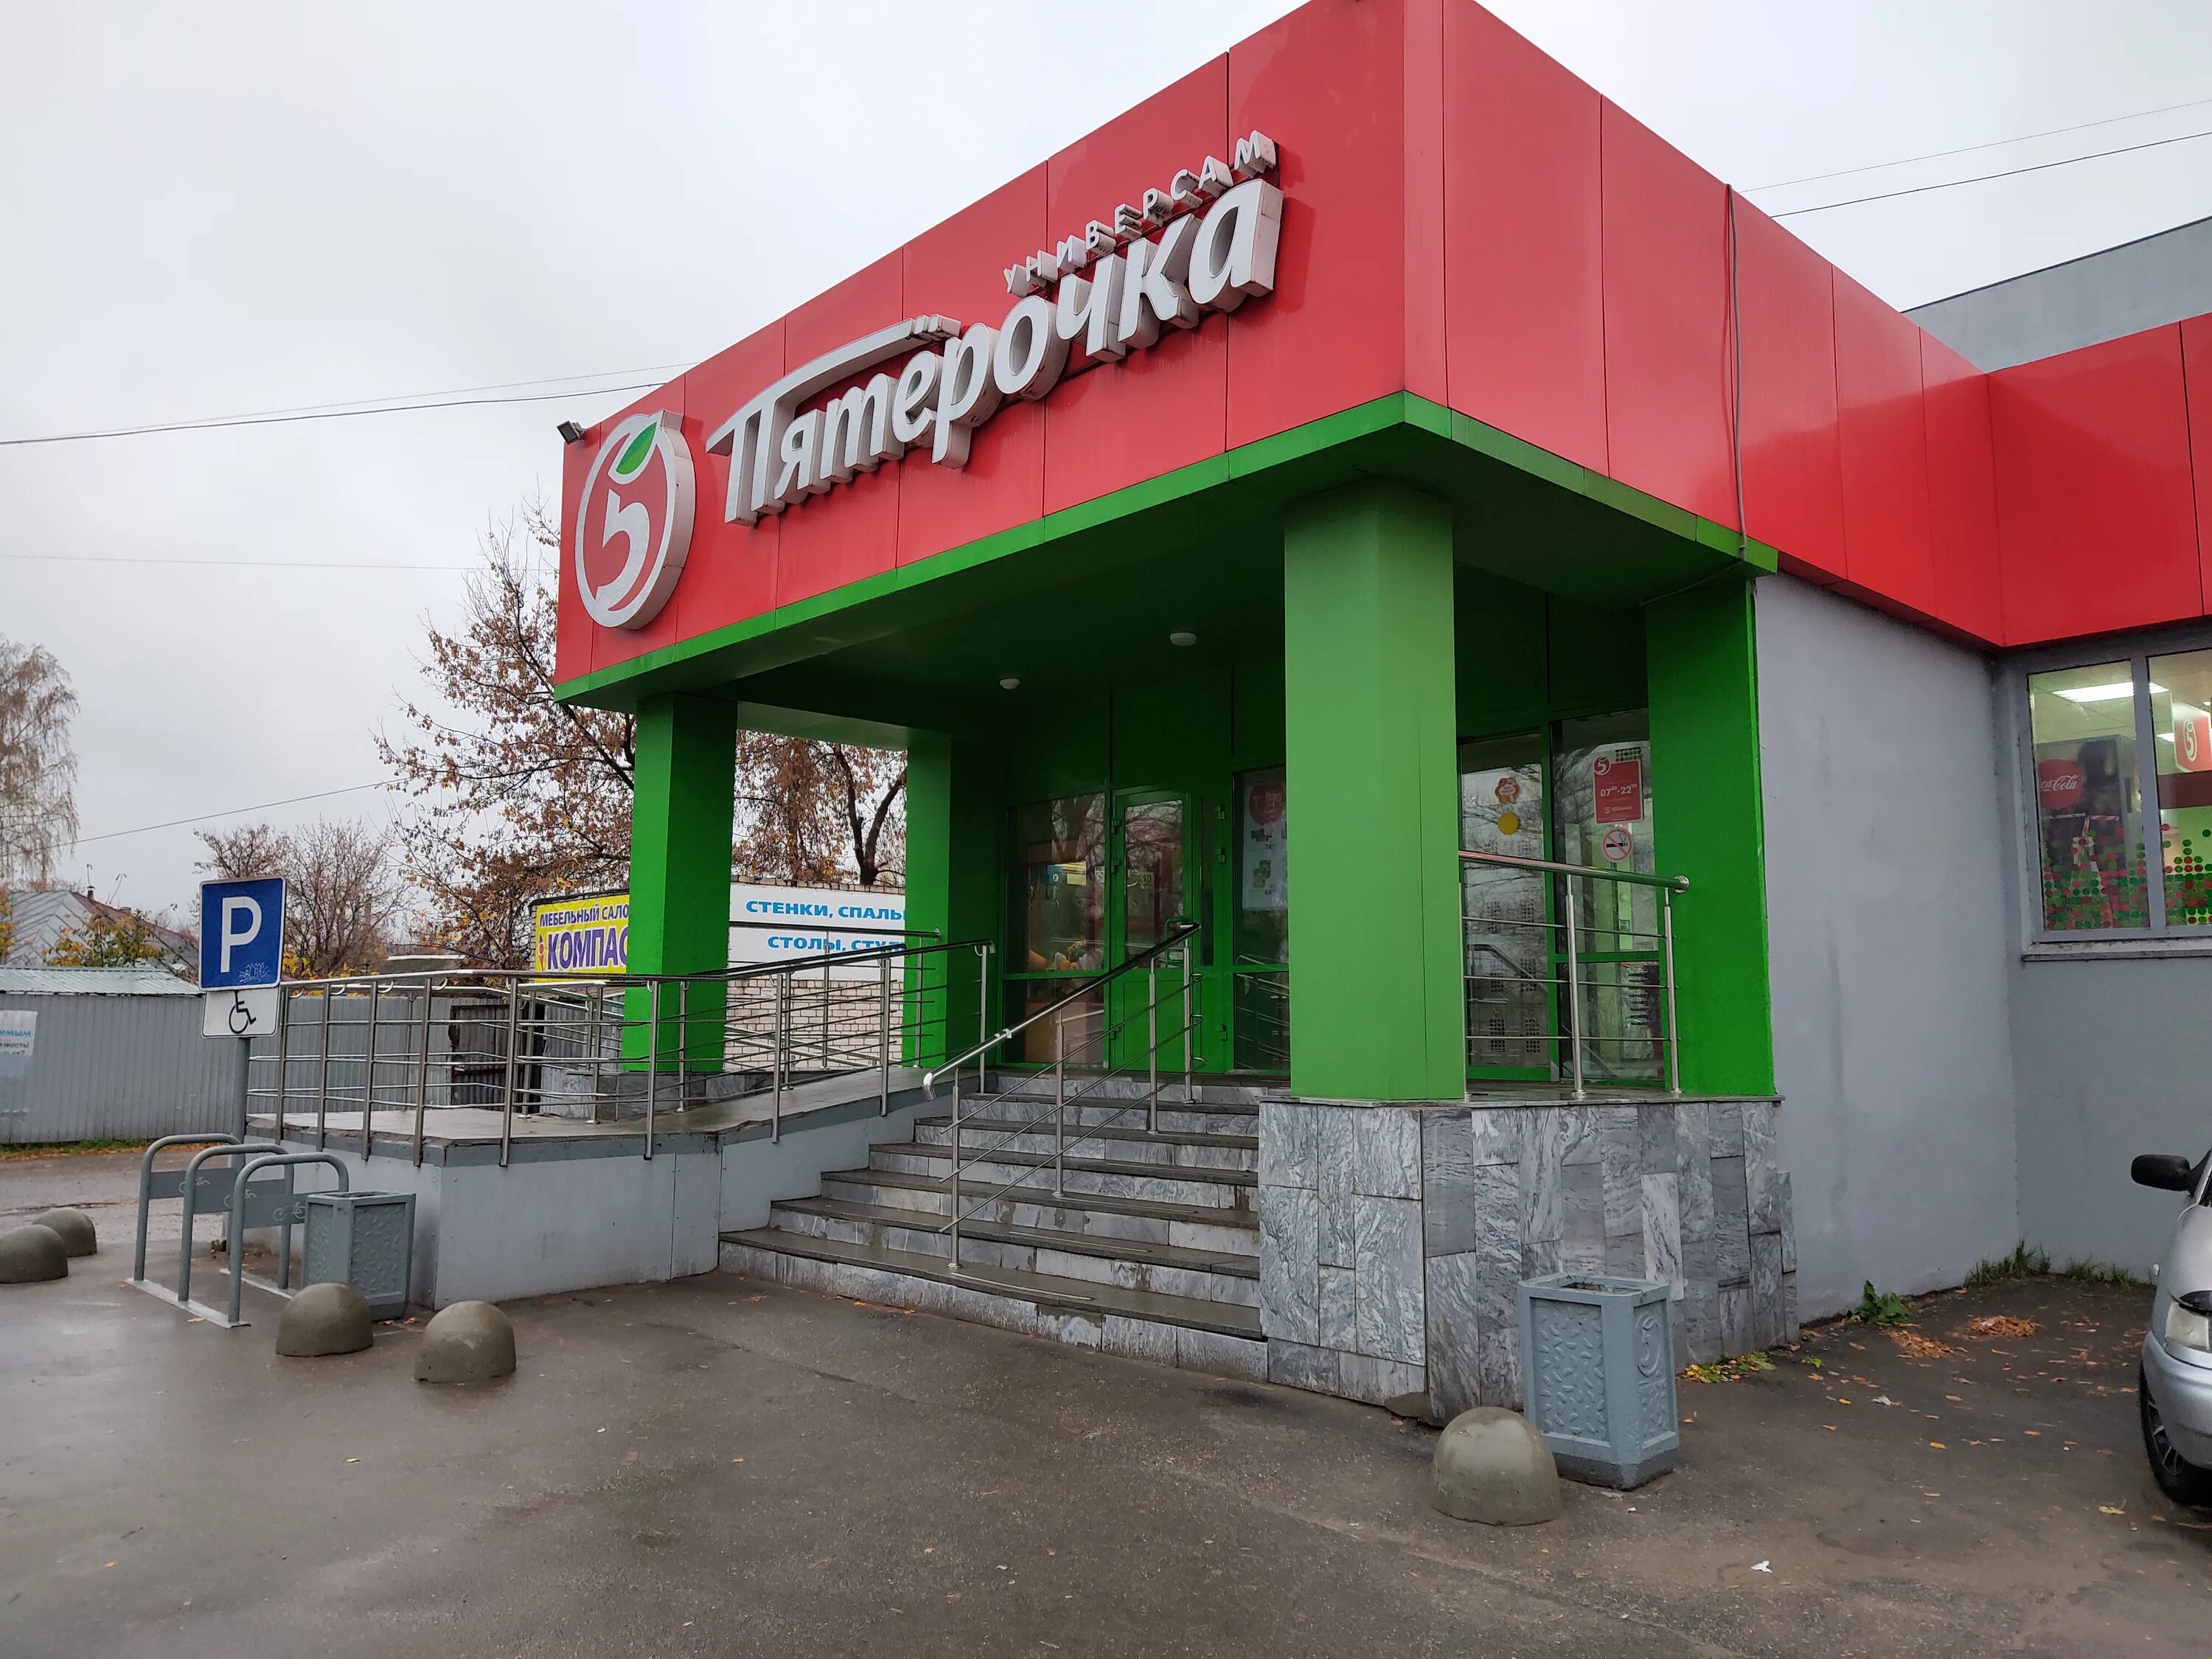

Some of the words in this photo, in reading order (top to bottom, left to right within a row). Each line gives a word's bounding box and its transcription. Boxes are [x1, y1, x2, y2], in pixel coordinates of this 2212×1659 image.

[1004, 130, 1276, 296] УНИВЕРСАМ
[540, 903, 599, 928] МЕБЕЛЬНЫЙ
[602, 904, 629, 920] САЛО
[745, 900, 834, 919] СТЕНКИ,
[838, 905, 905, 921] СПАЛЬ
[220, 897, 262, 973] P
[768, 936, 846, 952] СТОЛЫ,
